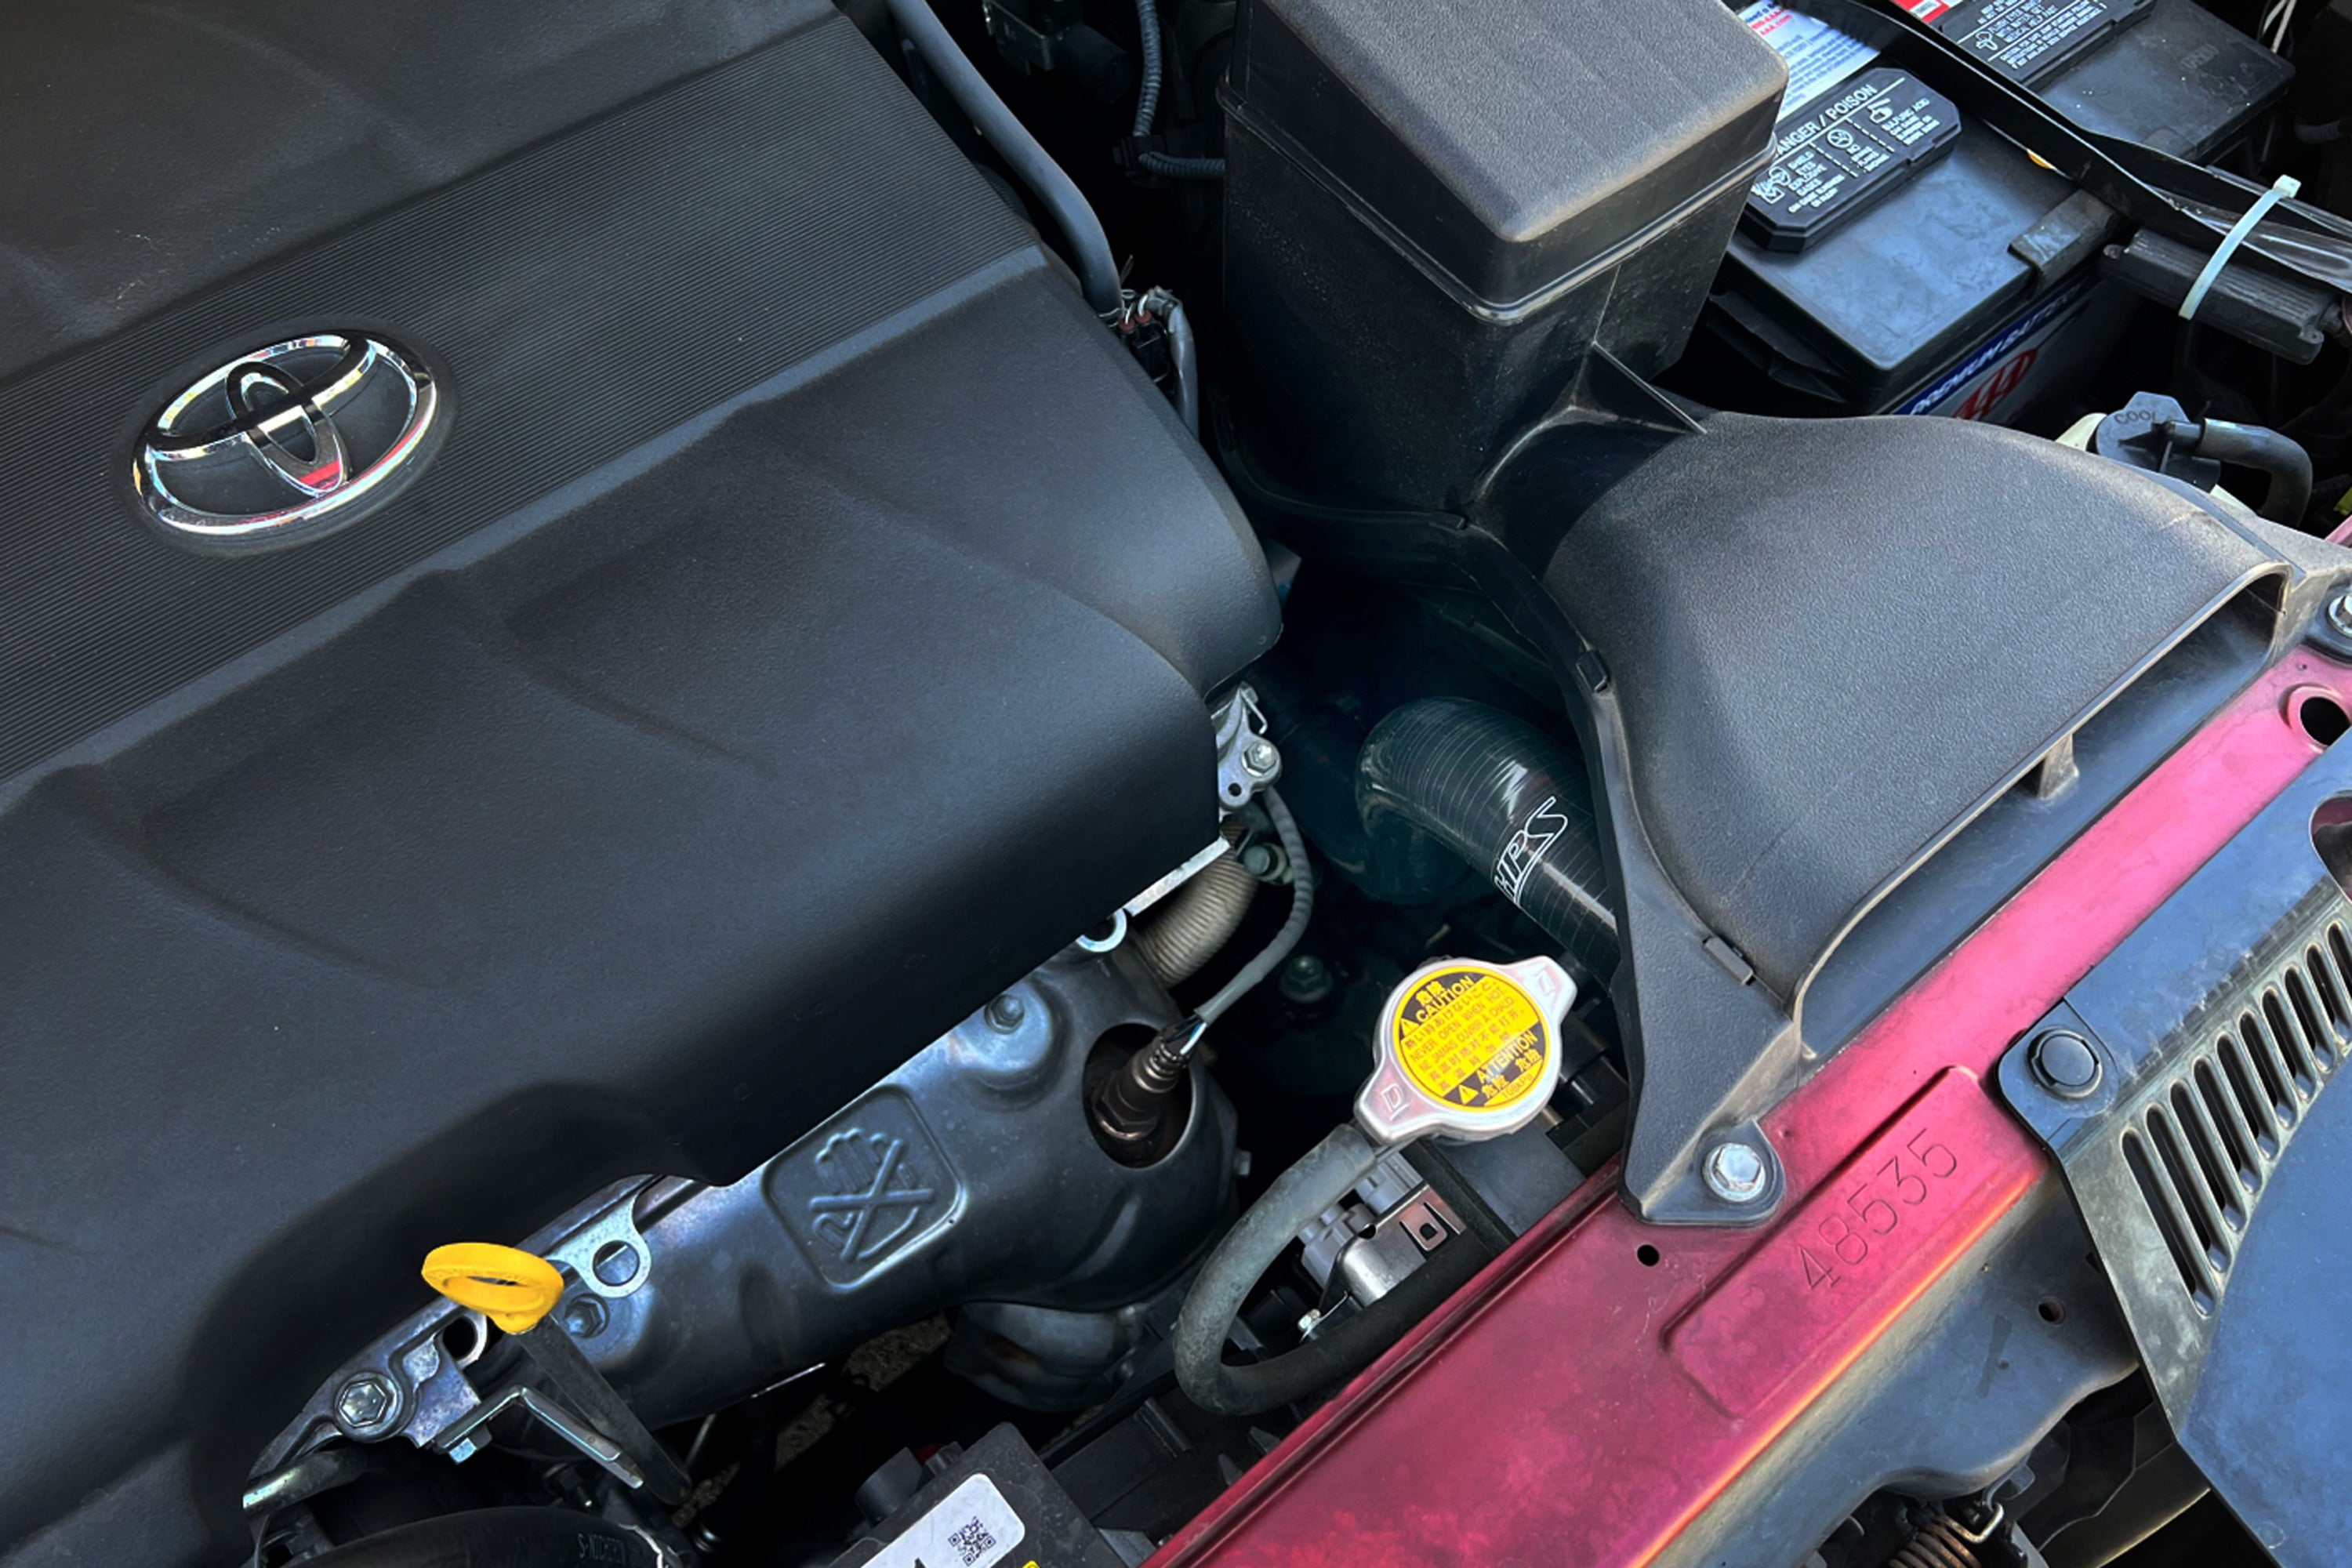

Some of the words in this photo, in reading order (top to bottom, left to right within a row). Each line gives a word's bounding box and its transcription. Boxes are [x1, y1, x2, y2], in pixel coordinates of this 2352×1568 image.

[1776, 121, 1820, 158] ANGER
[1825, 84, 1878, 120] POISON
[1416, 975, 1475, 1022] CAUTION
[1411, 1039, 1437, 1062] NEVER
[1439, 1020, 1461, 1040] OPEN
[1463, 1001, 1486, 1021] WHEN
[1476, 1029, 1538, 1084] ATTENTION
[1798, 1127, 1958, 1290] 48535
